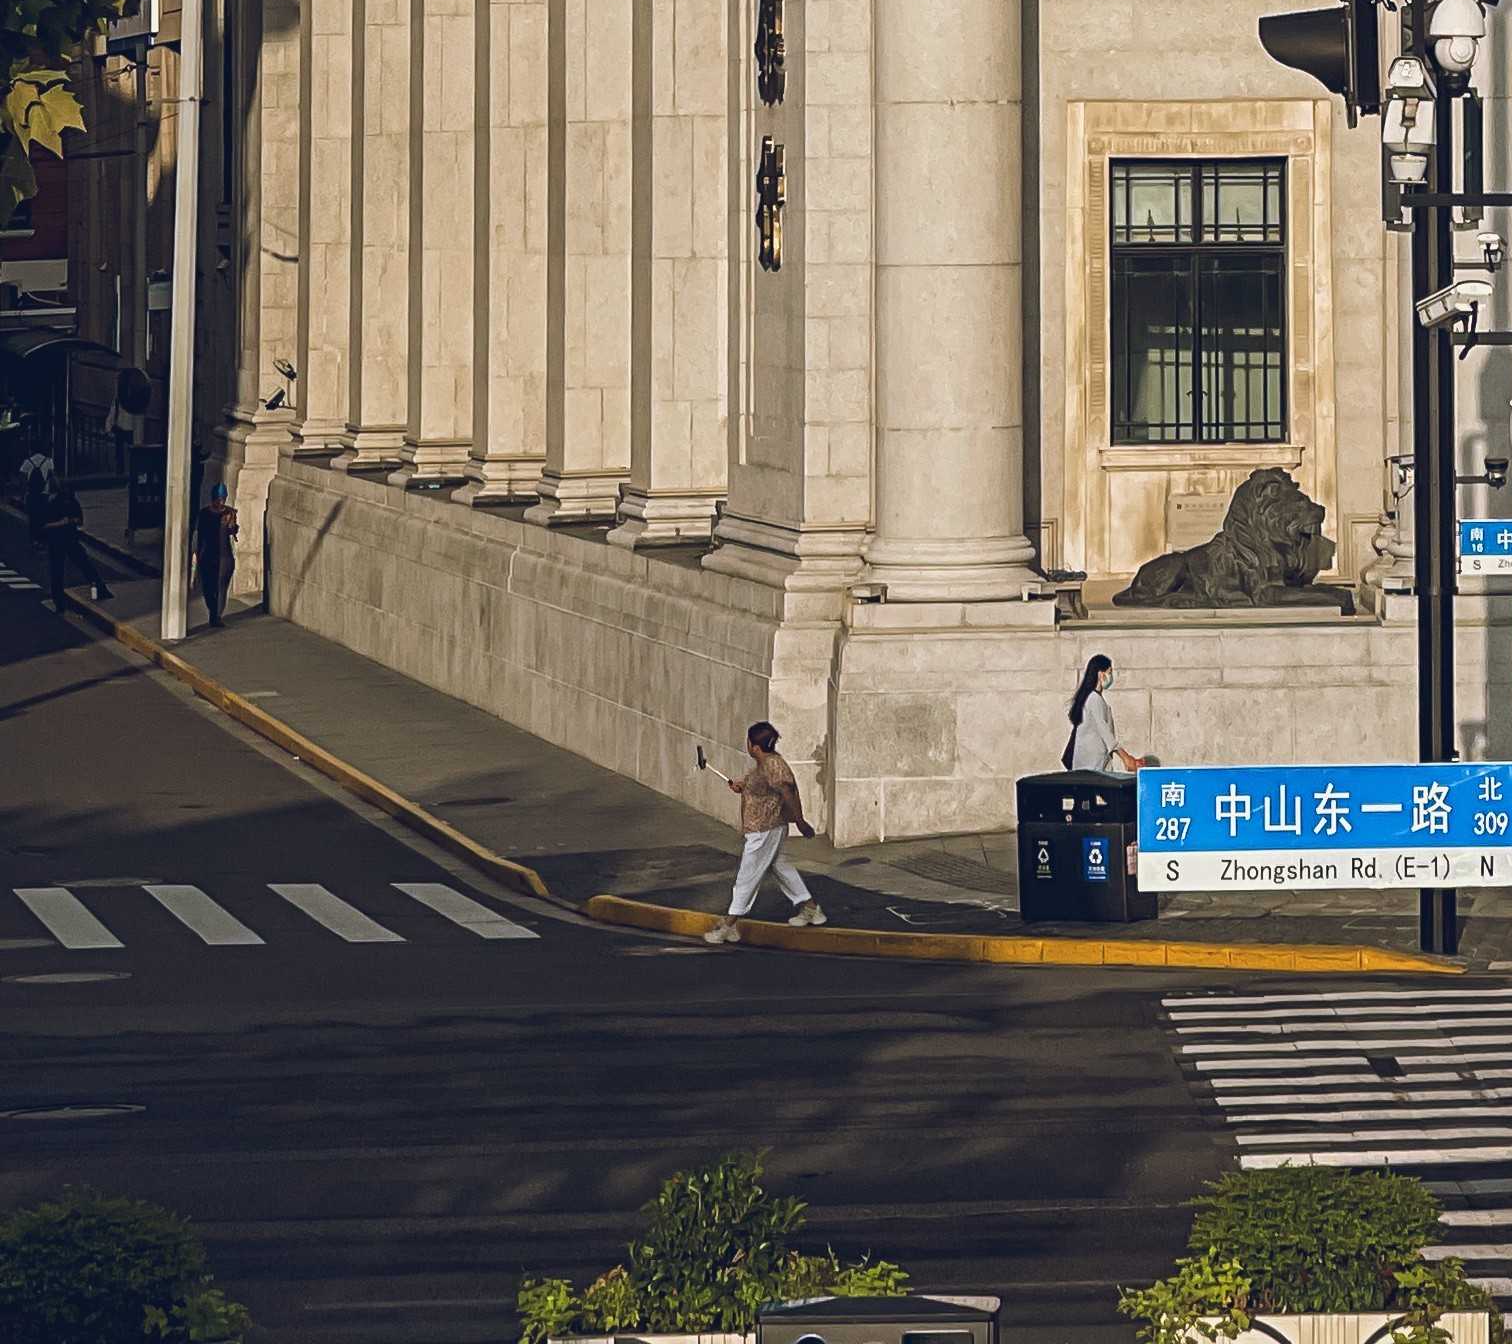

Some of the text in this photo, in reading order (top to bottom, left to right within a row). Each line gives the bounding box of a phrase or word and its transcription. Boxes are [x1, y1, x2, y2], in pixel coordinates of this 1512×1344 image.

[1473, 559, 1482, 570] S
[1160, 776, 1503, 837] 南 中山东一路 北
[1155, 812, 1509, 842] 287 309
[1166, 853, 1495, 884] S Zhongshan Rd. (E-1) N
